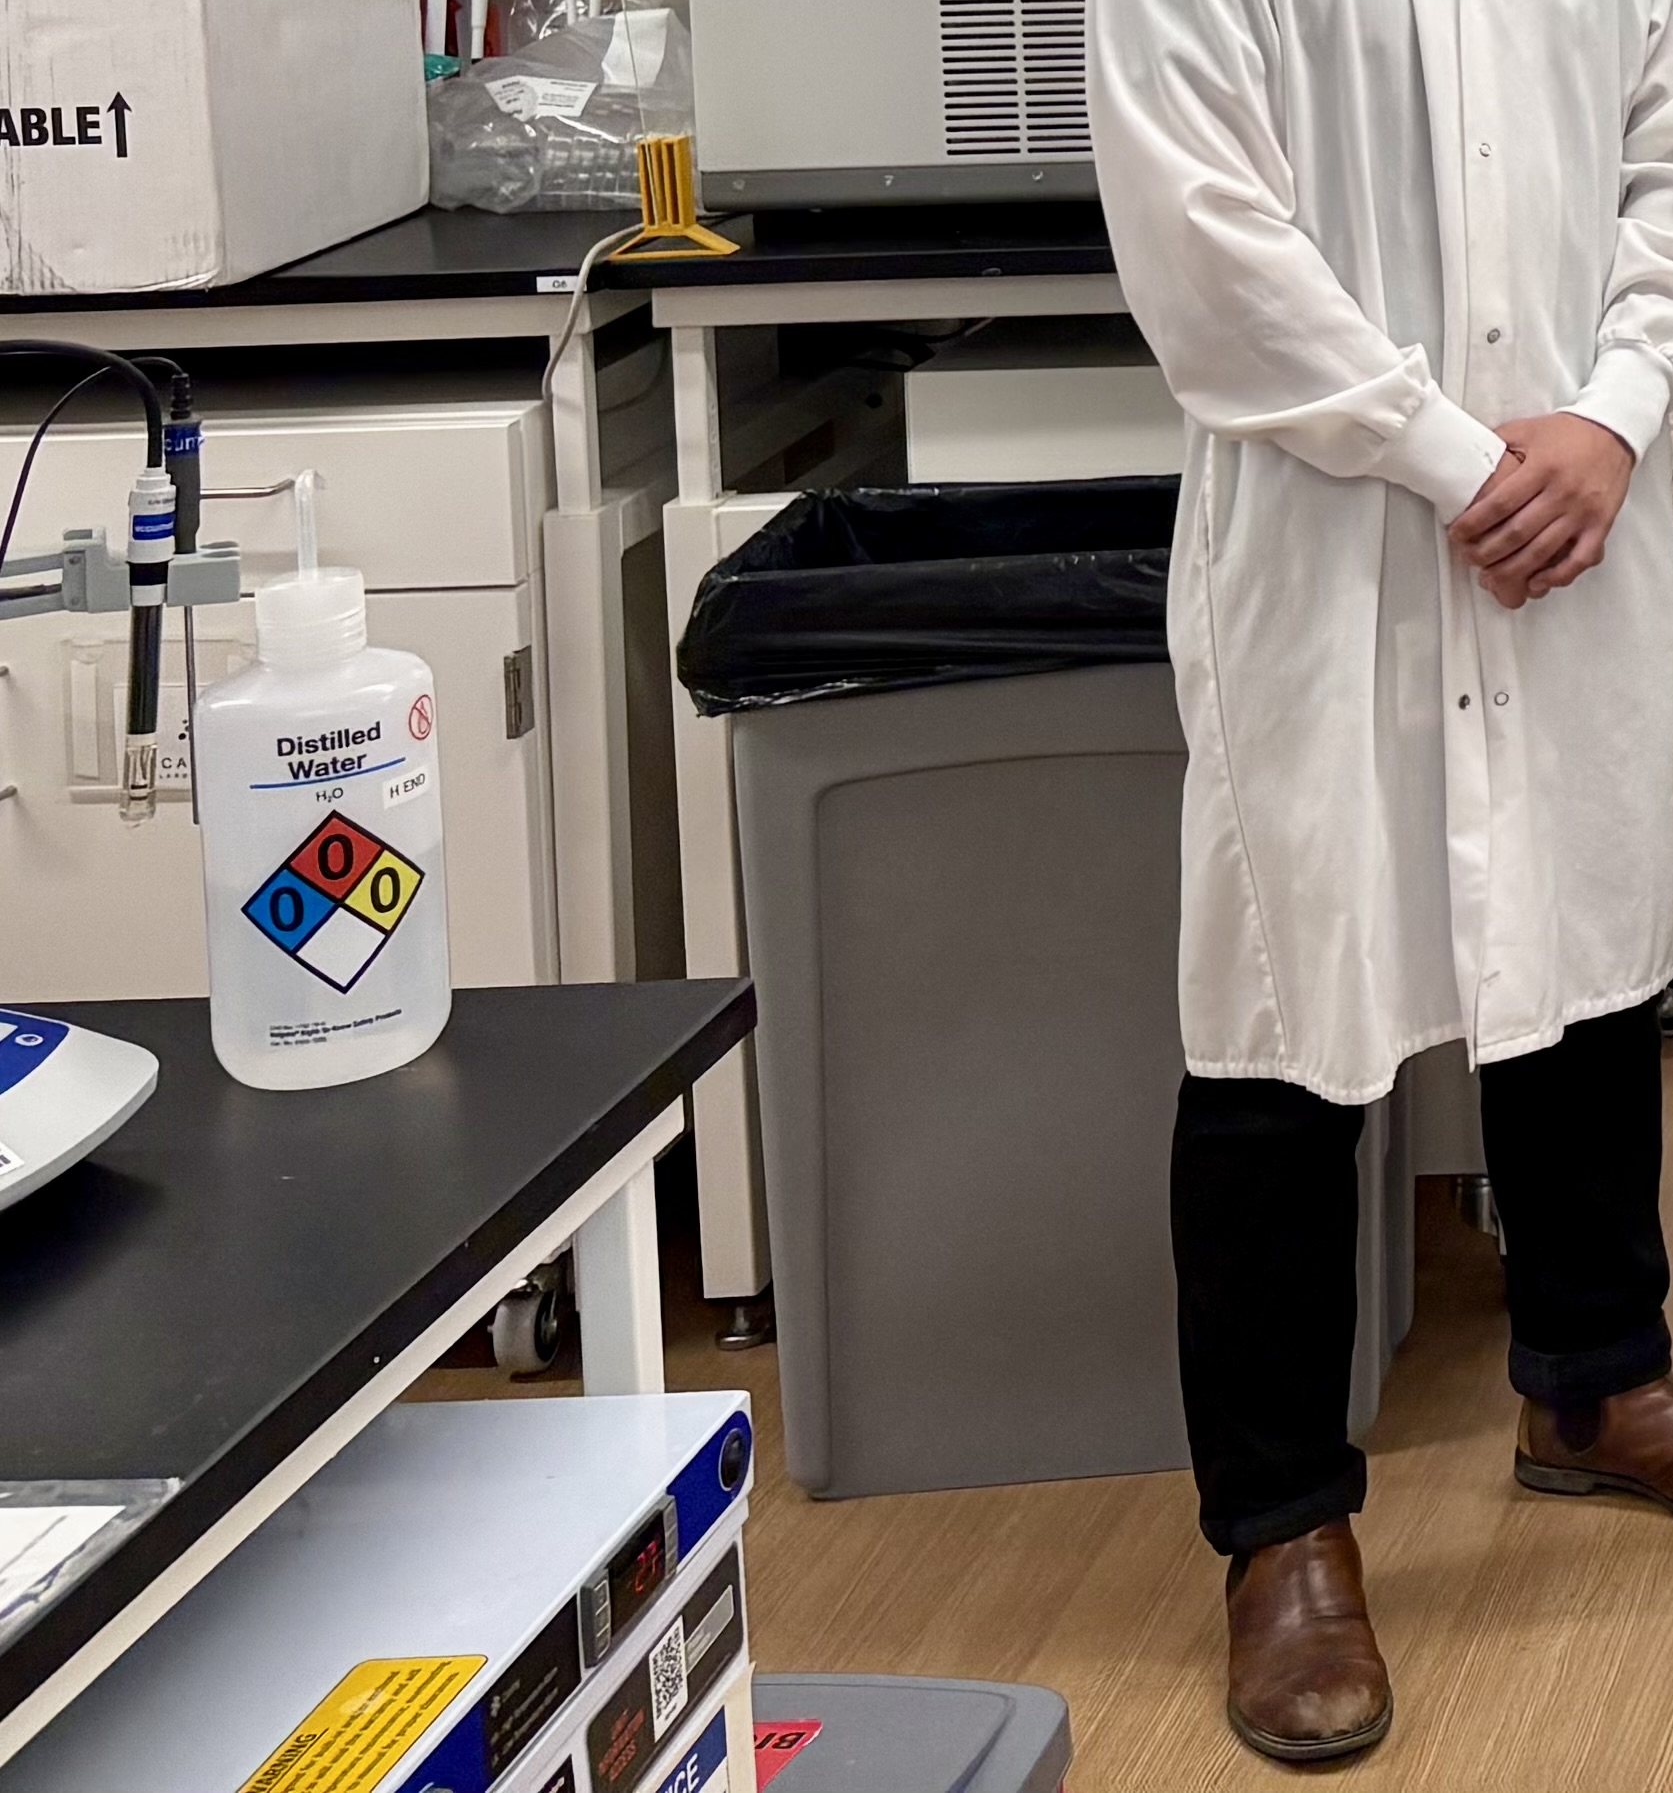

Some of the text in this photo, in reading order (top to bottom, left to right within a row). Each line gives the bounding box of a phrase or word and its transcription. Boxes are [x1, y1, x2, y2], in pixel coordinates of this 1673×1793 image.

[0, 106, 102, 147] ABLE
[277, 721, 381, 757] Distilled
[288, 754, 367, 781] Water
[318, 833, 354, 881] 0
[269, 886, 304, 932] 0
[370, 866, 400, 914] 0
